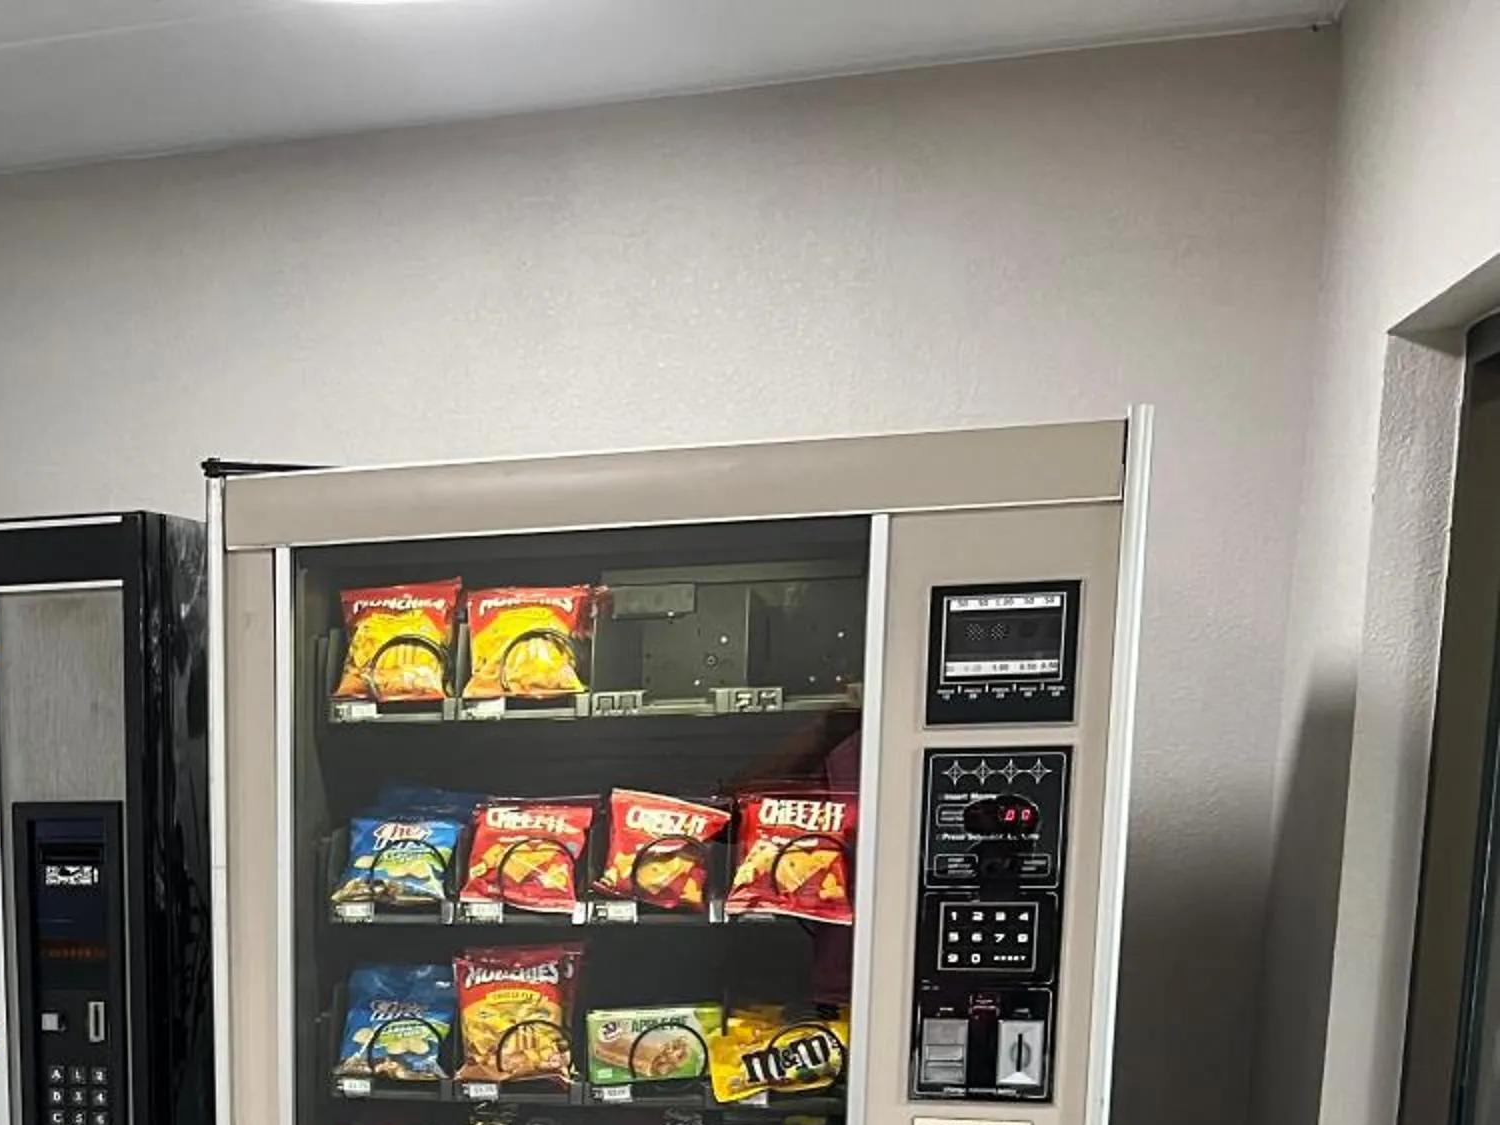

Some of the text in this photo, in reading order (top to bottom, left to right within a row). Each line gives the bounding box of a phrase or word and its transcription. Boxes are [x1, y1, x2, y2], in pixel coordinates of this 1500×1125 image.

[758, 798, 846, 832] CHEEZ-IT
[951, 911, 958, 921] 1
[972, 911, 985, 921] 2
[1018, 911, 1030, 921] 4
[993, 932, 1005, 942] 7
[465, 963, 560, 988] MUNCHIES
